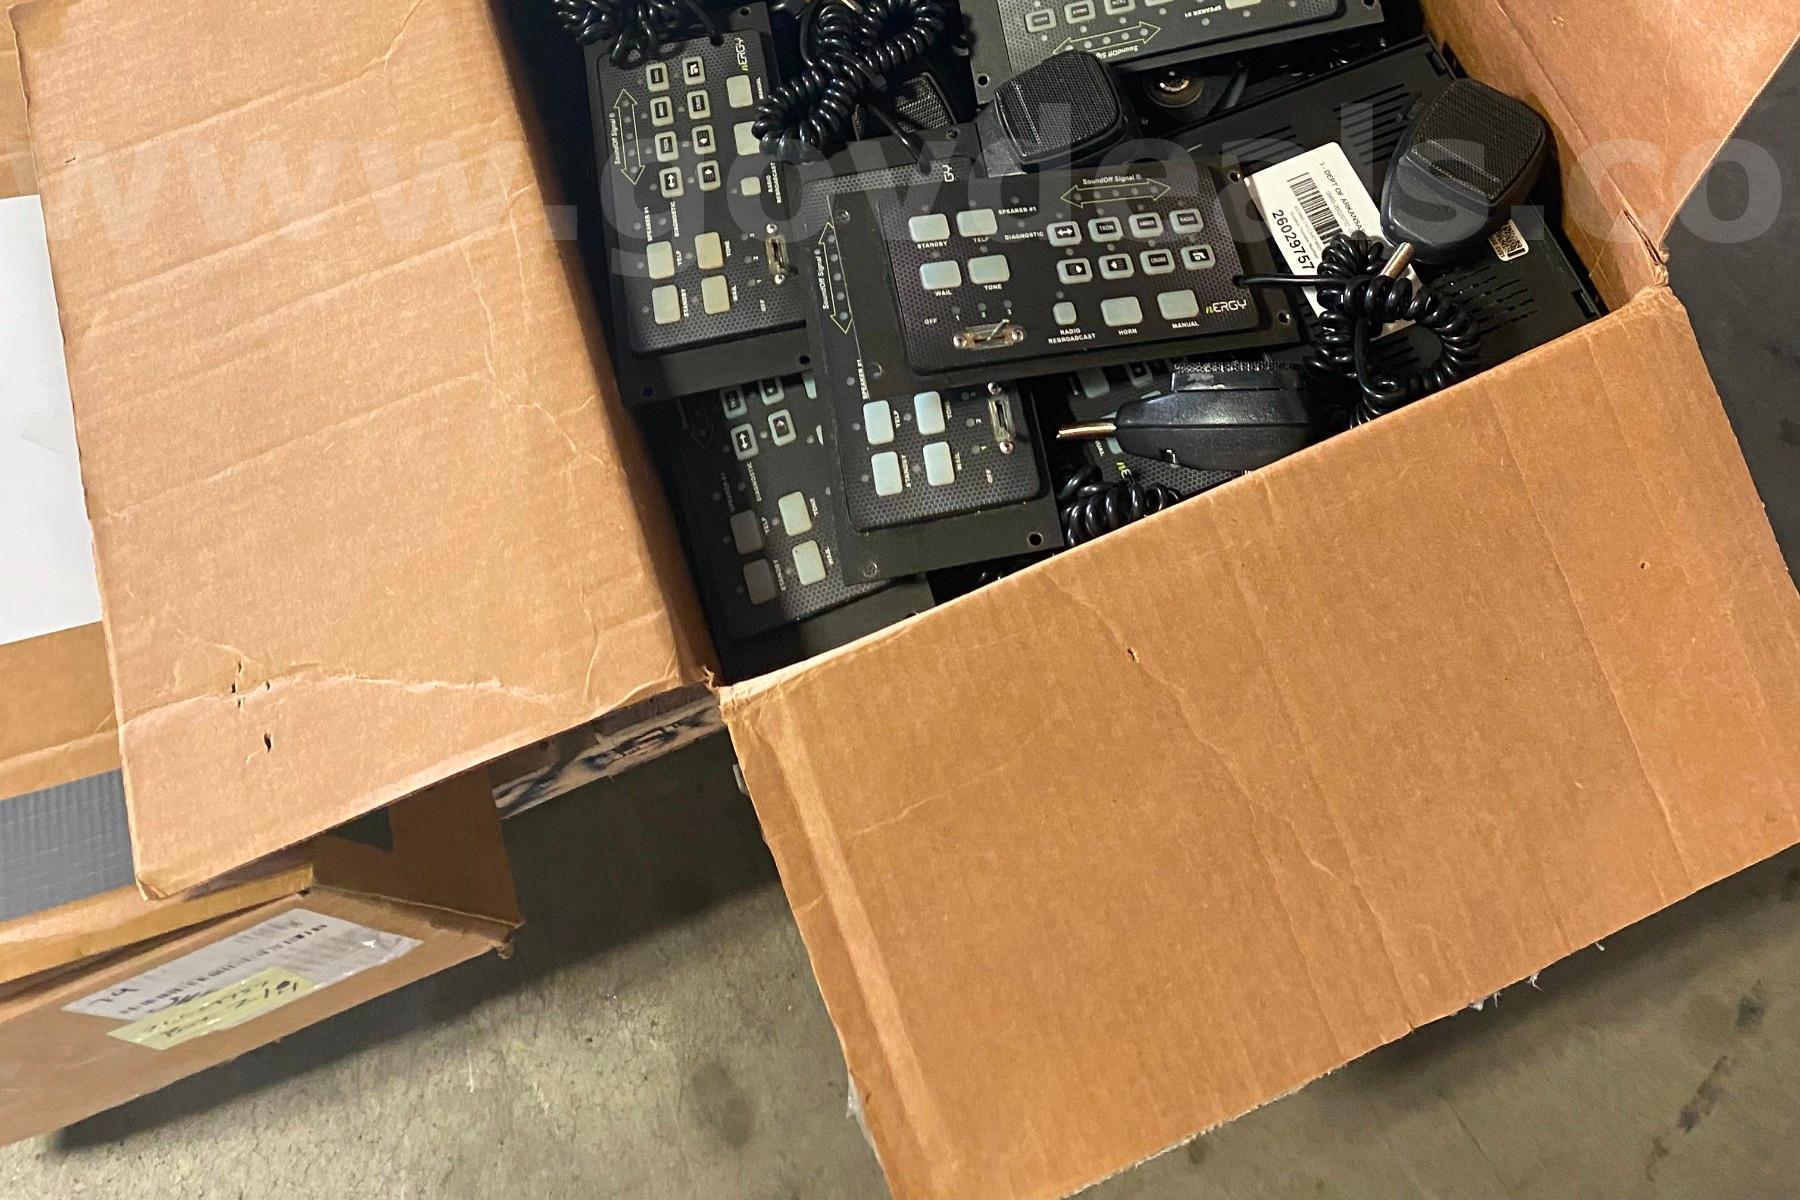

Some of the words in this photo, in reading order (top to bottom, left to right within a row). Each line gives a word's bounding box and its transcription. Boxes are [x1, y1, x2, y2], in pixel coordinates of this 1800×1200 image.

[1083, 176, 1114, 185] SoundOff
[1114, 174, 1135, 183] Signal
[1324, 169, 1338, 187] DEPT
[1335, 188, 1344, 197] OF
[1004, 231, 1044, 240] DIAGNOSTIC
[1272, 210, 1315, 270] 26029757
[917, 240, 948, 249] STANDBY
[1205, 299, 1247, 314] nERGY
[1171, 321, 1200, 329] MANUAL
[1059, 328, 1081, 336] RADIO
[1118, 328, 1137, 336] HORN
[1048, 333, 1096, 344] REBROADCAST
